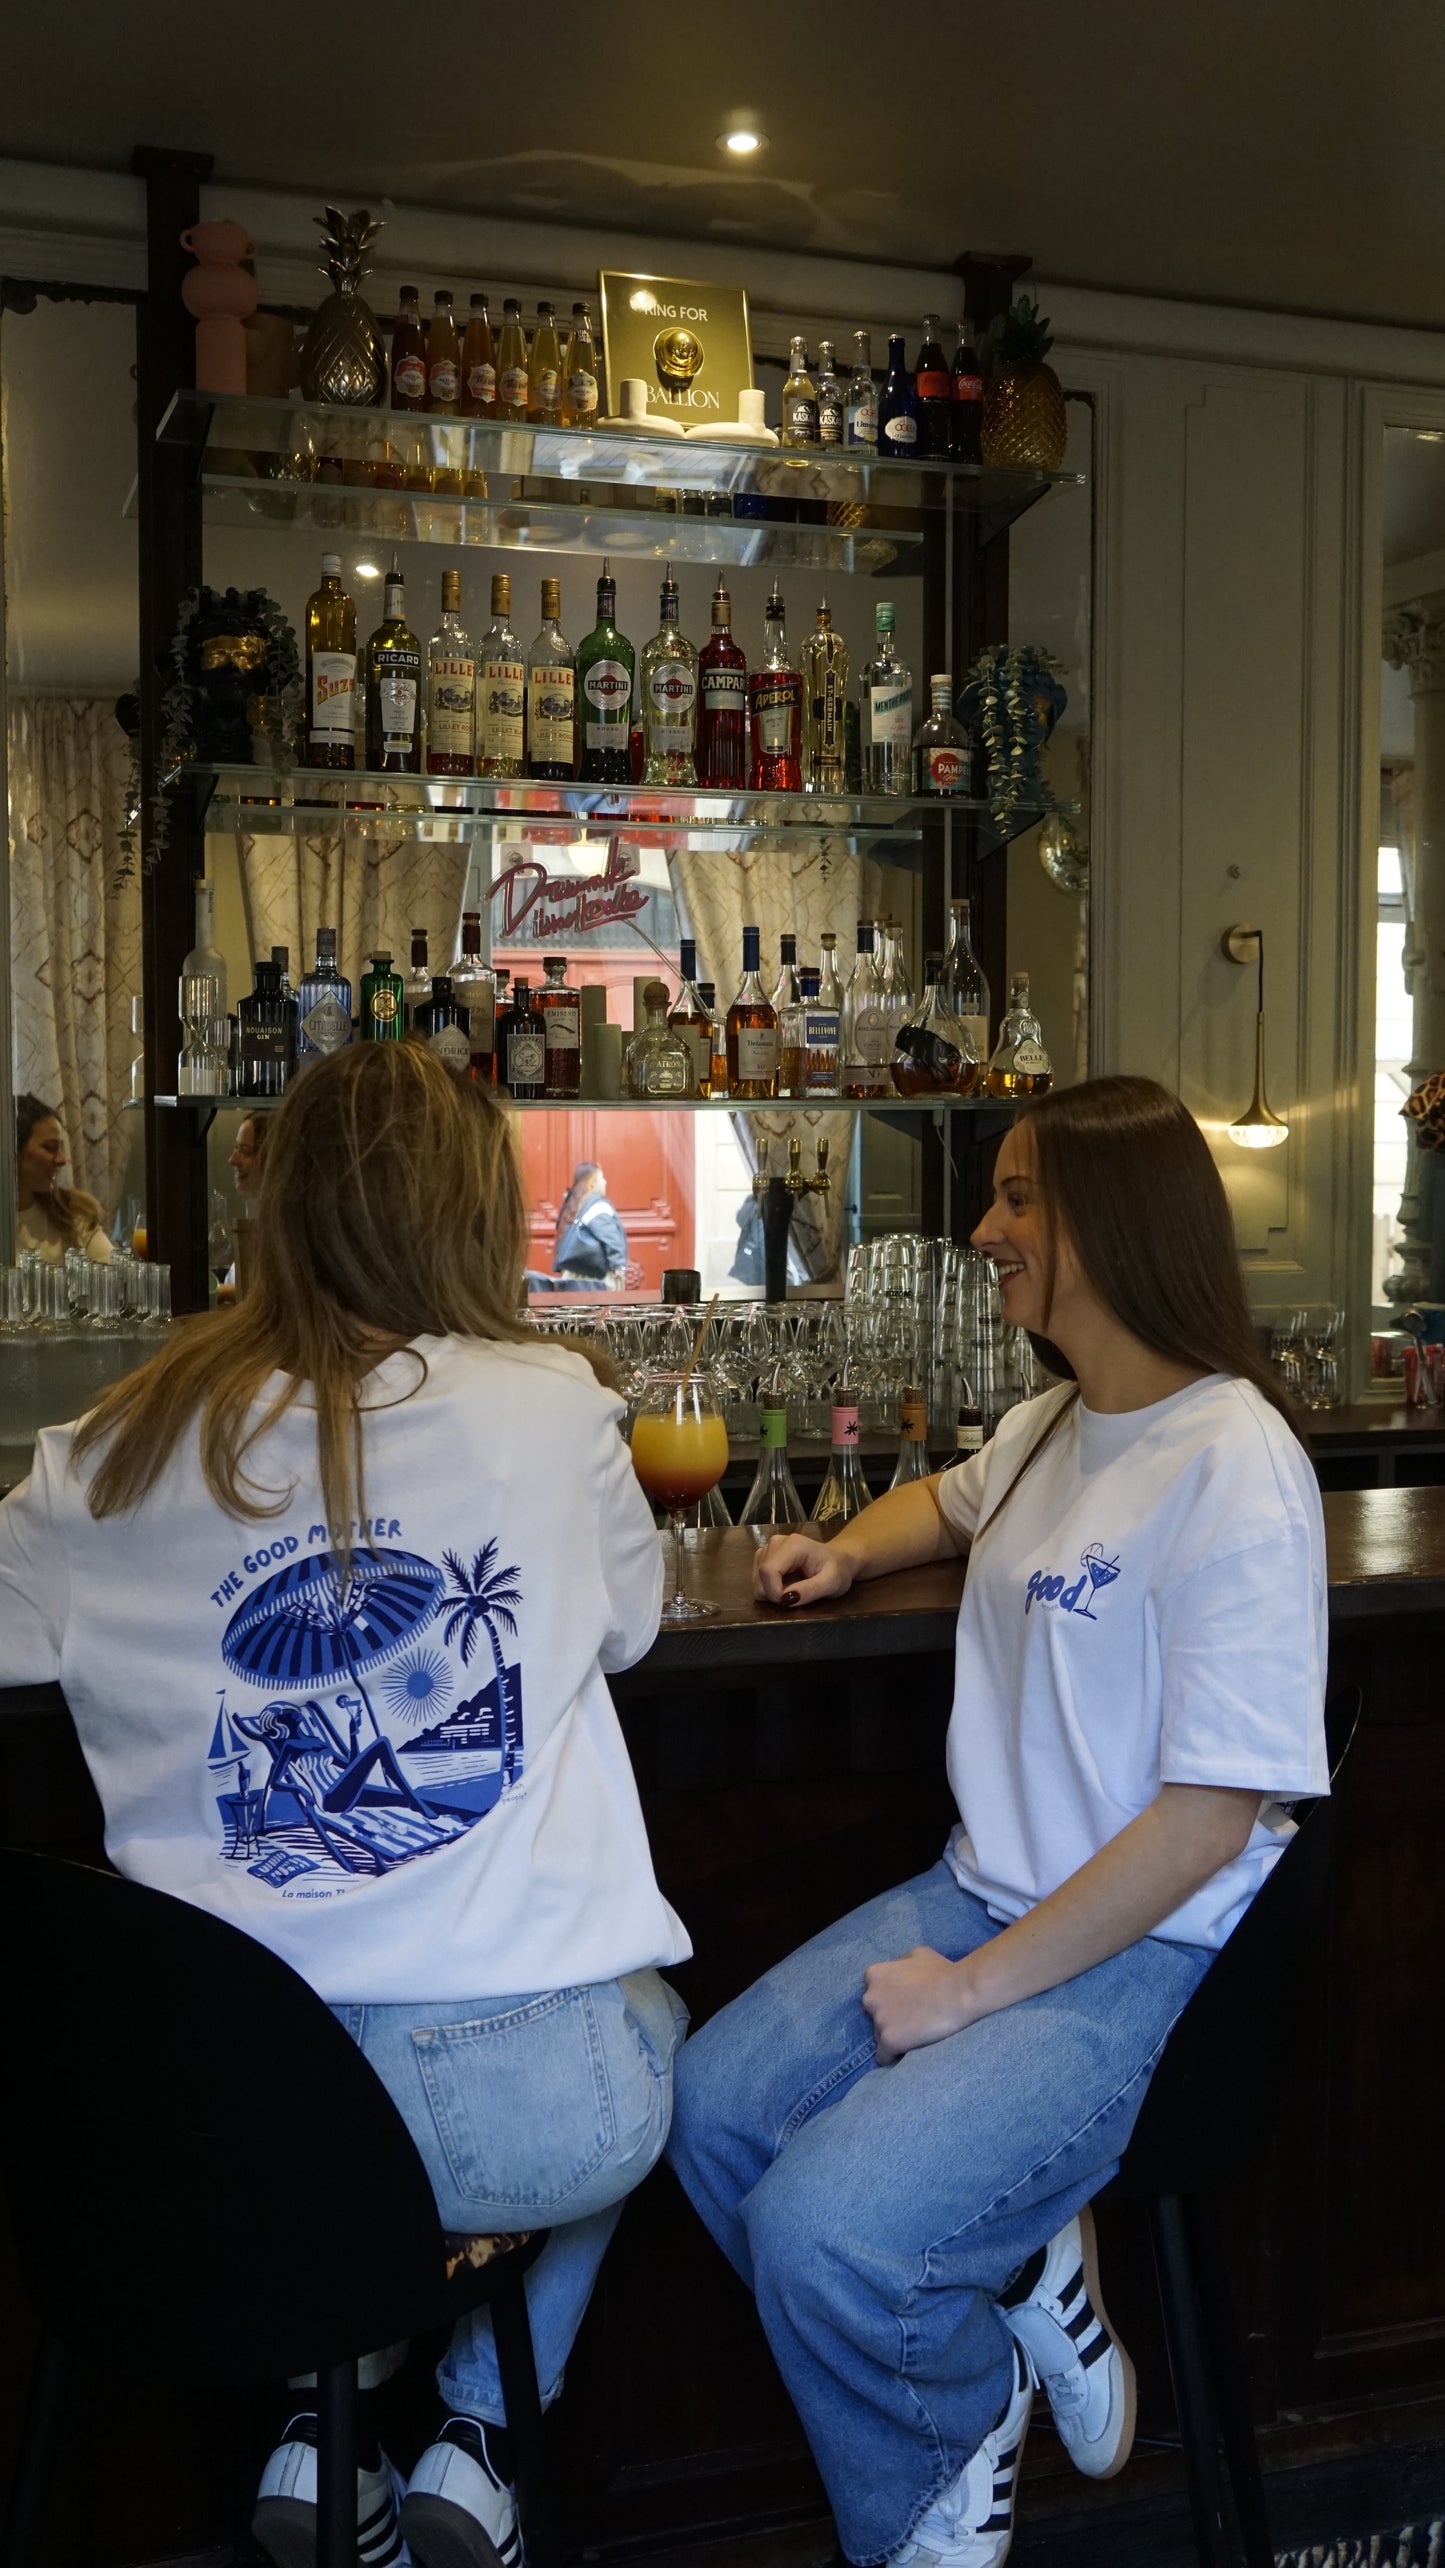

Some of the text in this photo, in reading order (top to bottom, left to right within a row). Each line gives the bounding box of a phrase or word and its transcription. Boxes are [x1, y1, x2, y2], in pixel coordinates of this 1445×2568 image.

[644, 304, 708, 321] RING FOR
[646, 386, 720, 408] BALLION
[377, 653, 419, 665] RICARD
[435, 662, 473, 676] LILLE
[488, 666, 523, 680] LILLE
[534, 671, 573, 685] LILLE
[701, 676, 745, 690] CAMPAR
[588, 681, 628, 690] MARTINI
[654, 684, 692, 693] MARTINI
[755, 689, 796, 708] APEROL
[245, 1026, 283, 1034] NOUAISON
[210, 1518, 402, 1608] THE GOOD MHER
[1025, 1570, 1088, 1615] good
[281, 1889, 294, 1898] La
[296, 1888, 332, 1898] maison
